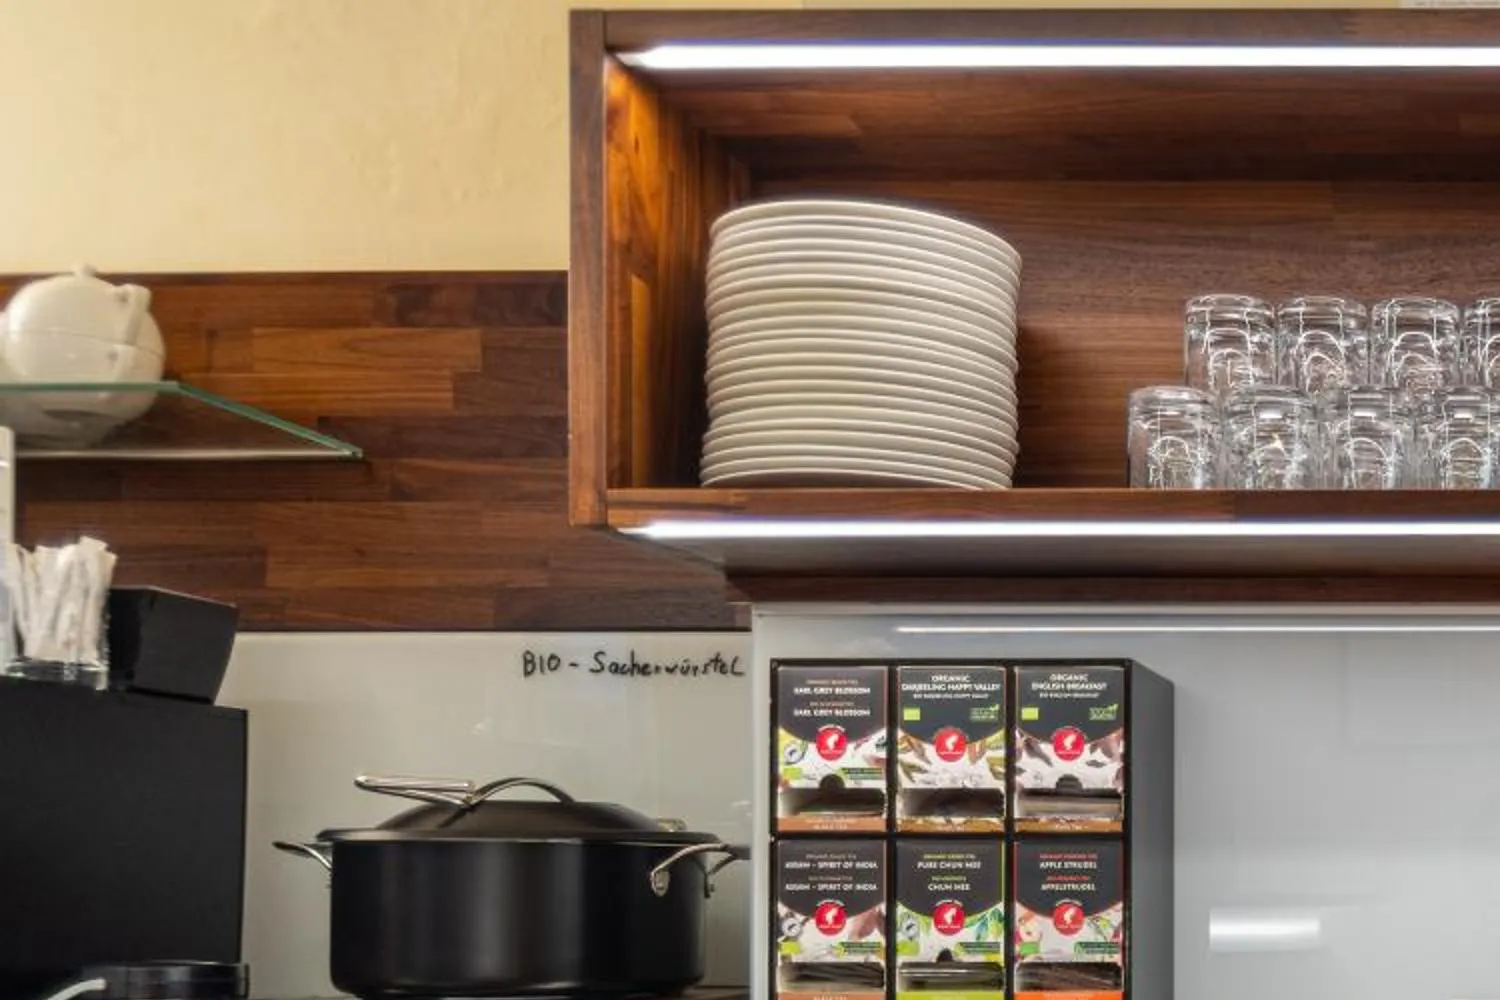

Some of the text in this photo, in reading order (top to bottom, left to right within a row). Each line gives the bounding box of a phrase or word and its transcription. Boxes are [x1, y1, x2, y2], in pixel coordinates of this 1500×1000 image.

[522, 650, 562, 678] BIO
[1032, 682, 1108, 690] ENGLISH BREAKFAST
[939, 861, 963, 870] CHUN
[1039, 861, 1098, 869] APPLE STRUDEL
